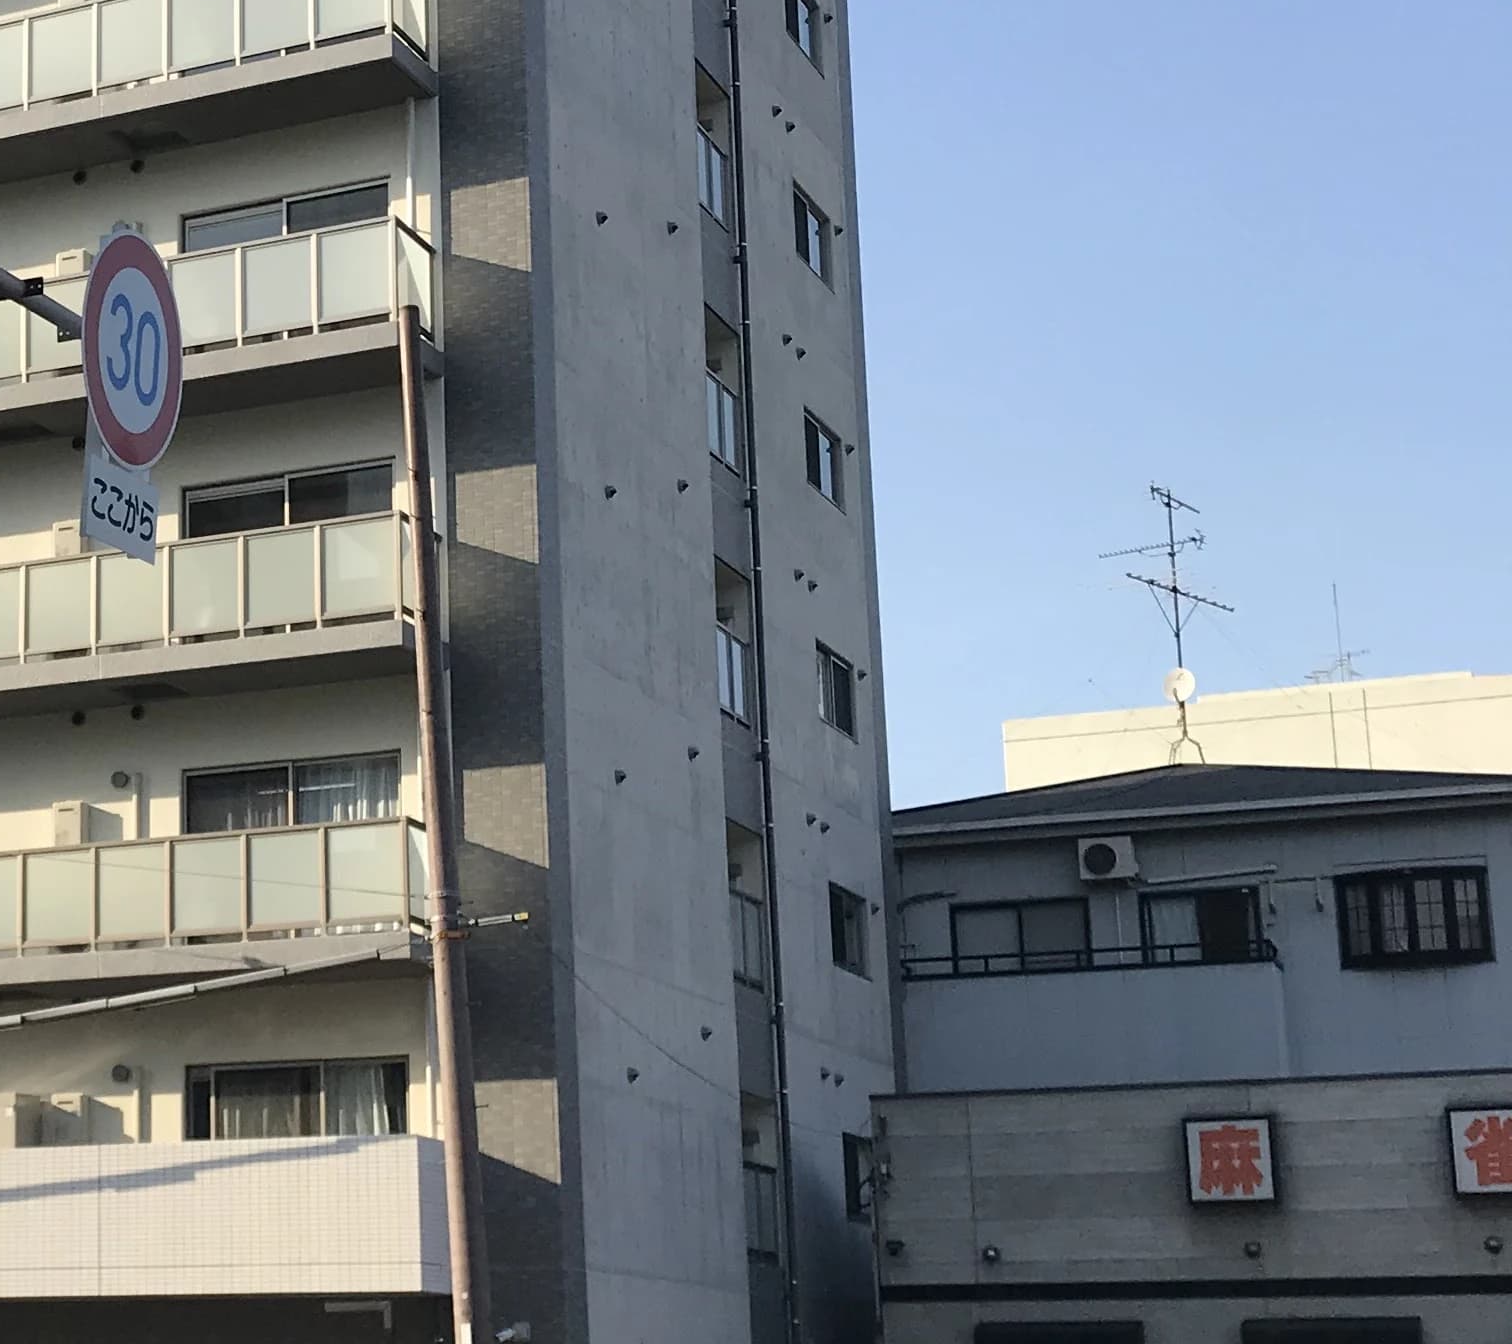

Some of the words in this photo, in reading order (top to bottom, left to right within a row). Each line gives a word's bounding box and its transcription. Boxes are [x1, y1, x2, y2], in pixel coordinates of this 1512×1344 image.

[106, 292, 161, 406] 30
[91, 477, 154, 542] ここから
[1198, 1124, 1263, 1195] 麻
